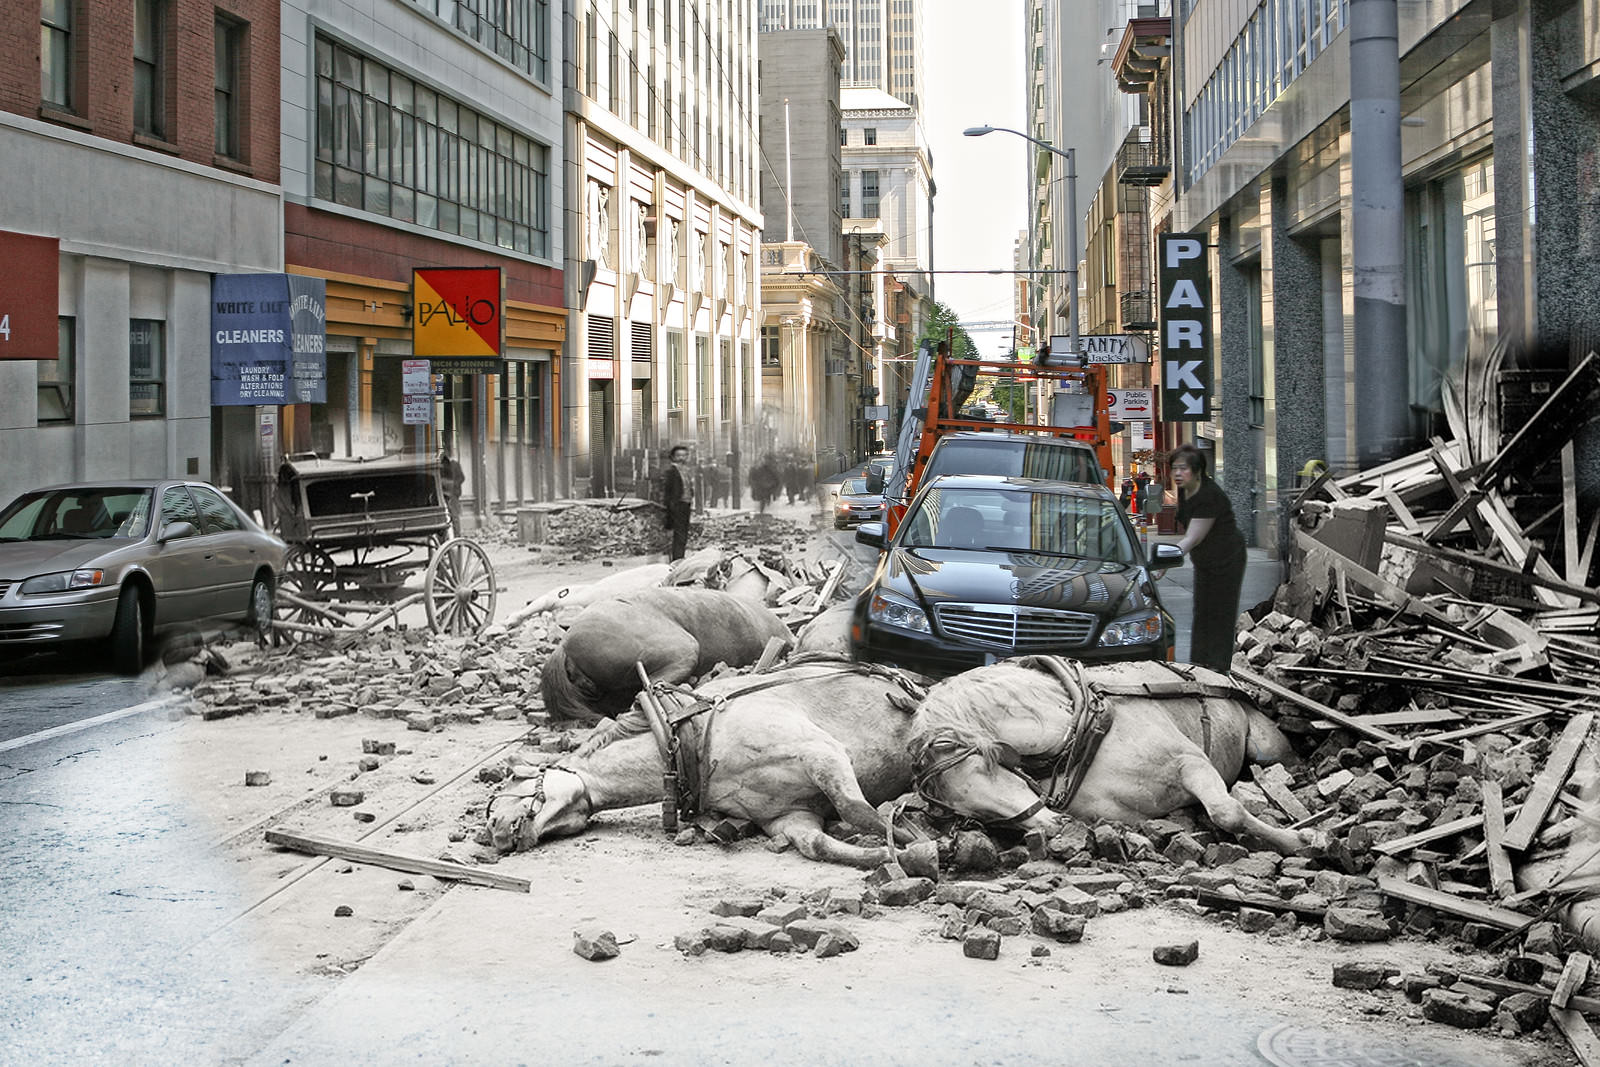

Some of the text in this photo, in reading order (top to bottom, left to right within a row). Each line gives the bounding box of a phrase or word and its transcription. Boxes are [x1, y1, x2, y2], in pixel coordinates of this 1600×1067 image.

[217, 302, 254, 314] WHITE
[1166, 239, 1205, 390] PARK
[216, 330, 284, 344] CLEANERS
[1089, 354, 1122, 362] Jack's
[241, 374, 260, 382] WASH
[262, 374, 267, 382] &
[268, 374, 285, 382] FOLD
[239, 389, 285, 398] DRY CLEANING
[1123, 398, 1149, 406] Parking
